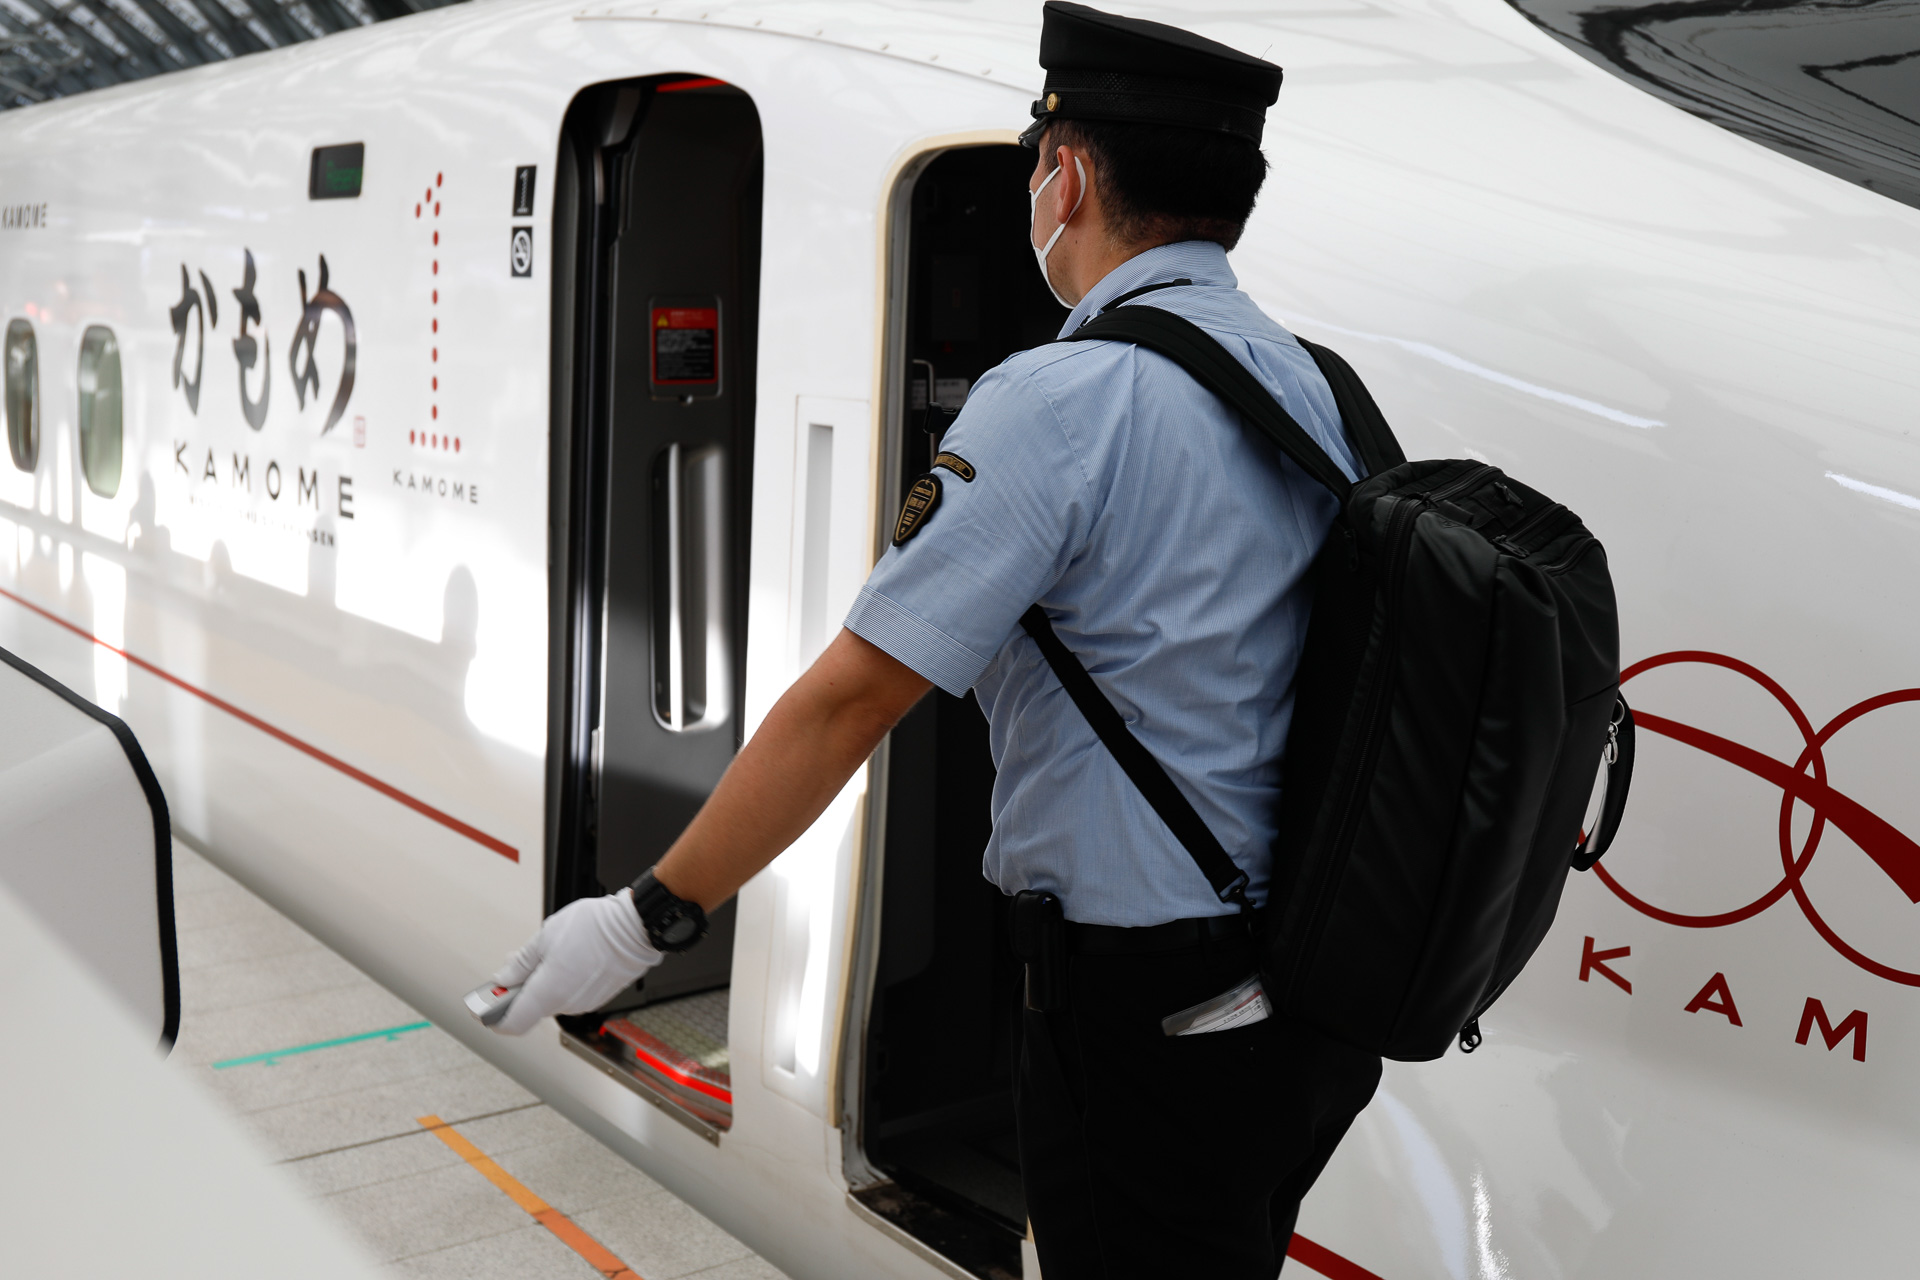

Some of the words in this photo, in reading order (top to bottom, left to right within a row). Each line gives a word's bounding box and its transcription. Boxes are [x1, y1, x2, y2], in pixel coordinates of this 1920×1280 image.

[1, 202, 48, 230] KAMOME
[170, 247, 357, 436] かもめ
[173, 438, 355, 520] KAMOME
[393, 468, 478, 505] KAMOME
[1578, 935, 1869, 1063] KAM
